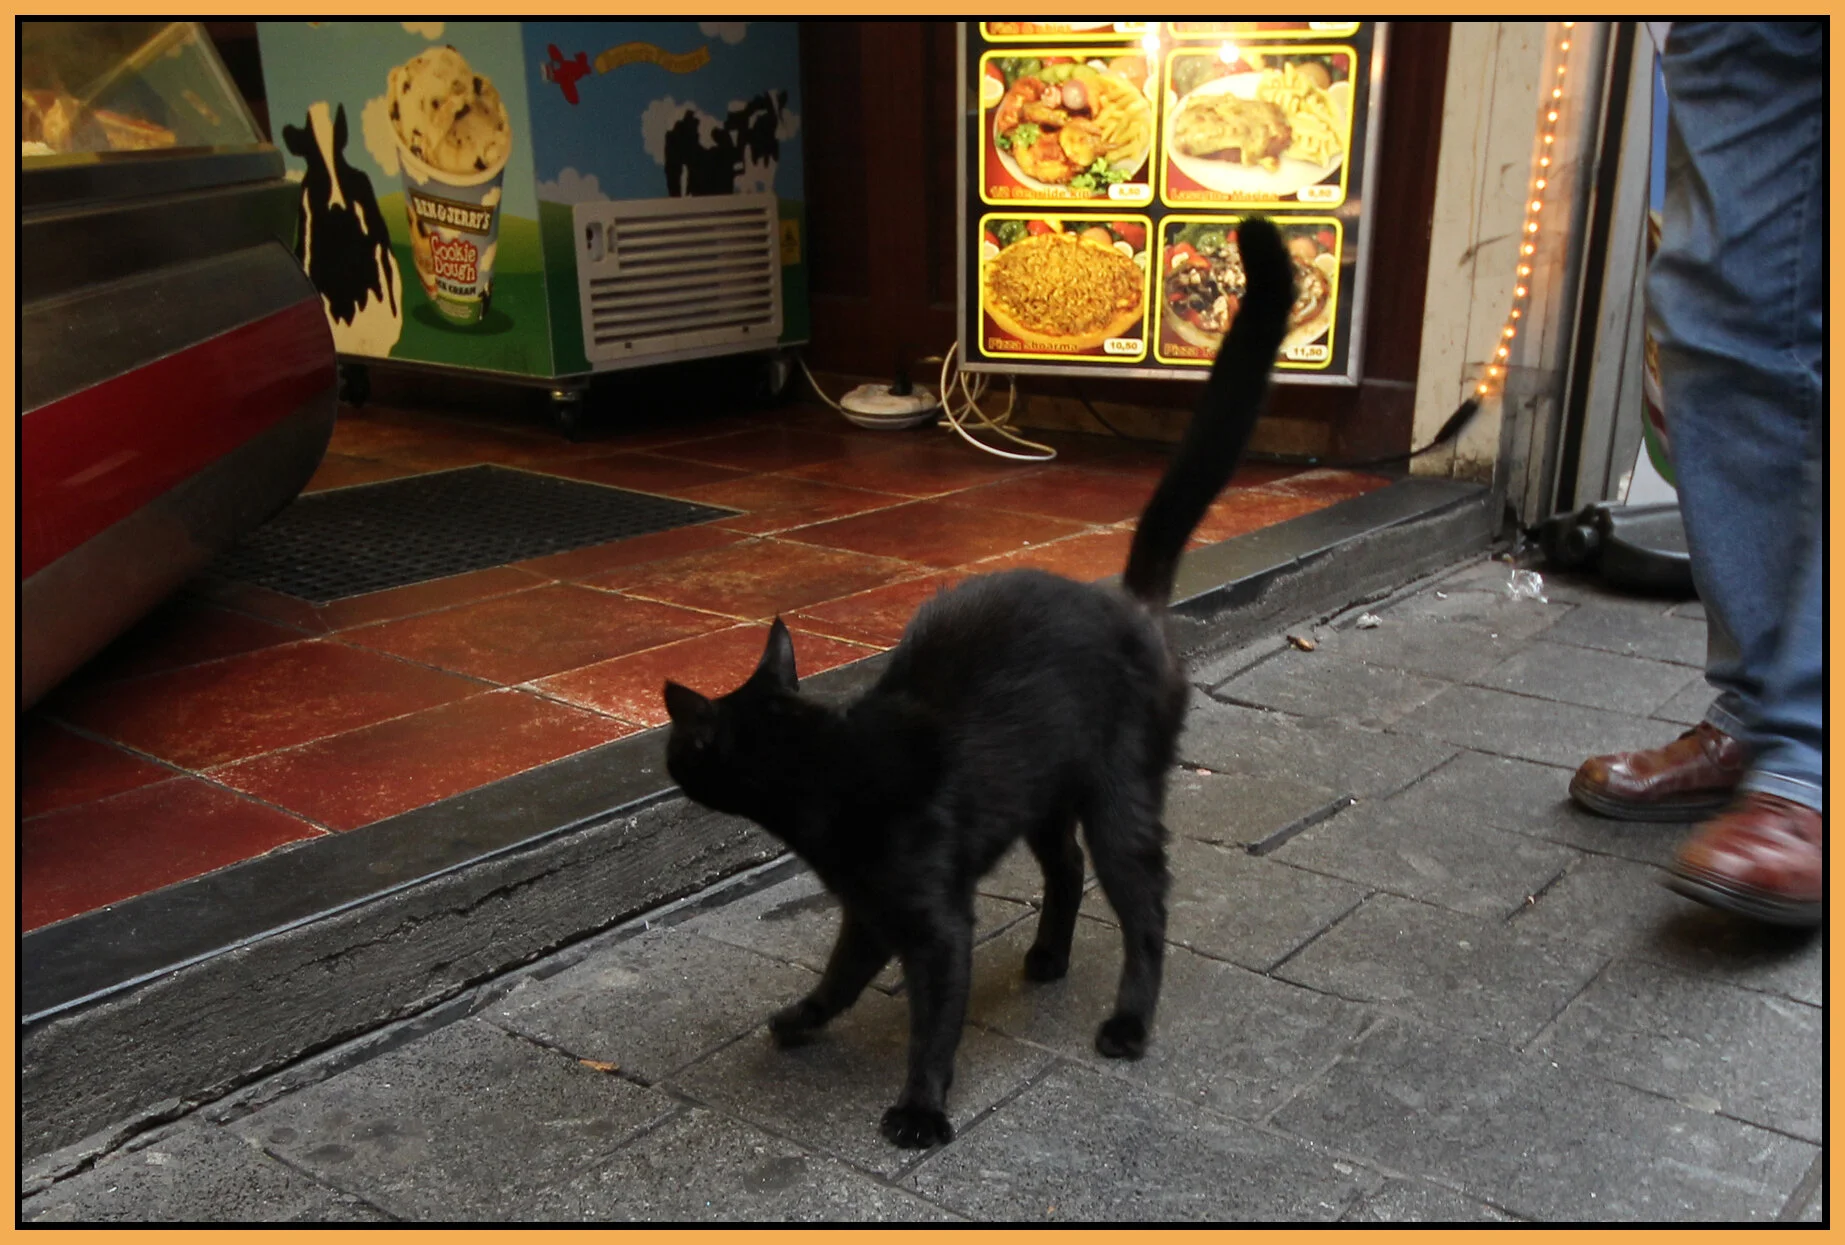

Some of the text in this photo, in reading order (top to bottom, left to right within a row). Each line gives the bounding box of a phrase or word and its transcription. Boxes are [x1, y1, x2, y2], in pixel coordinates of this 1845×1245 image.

[431, 236, 476, 262] Cookie
[434, 256, 476, 281] Dough
[988, 337, 1021, 350] Pizza
[1109, 340, 1138, 351] 10,50
[1292, 347, 1323, 358] 11,50
